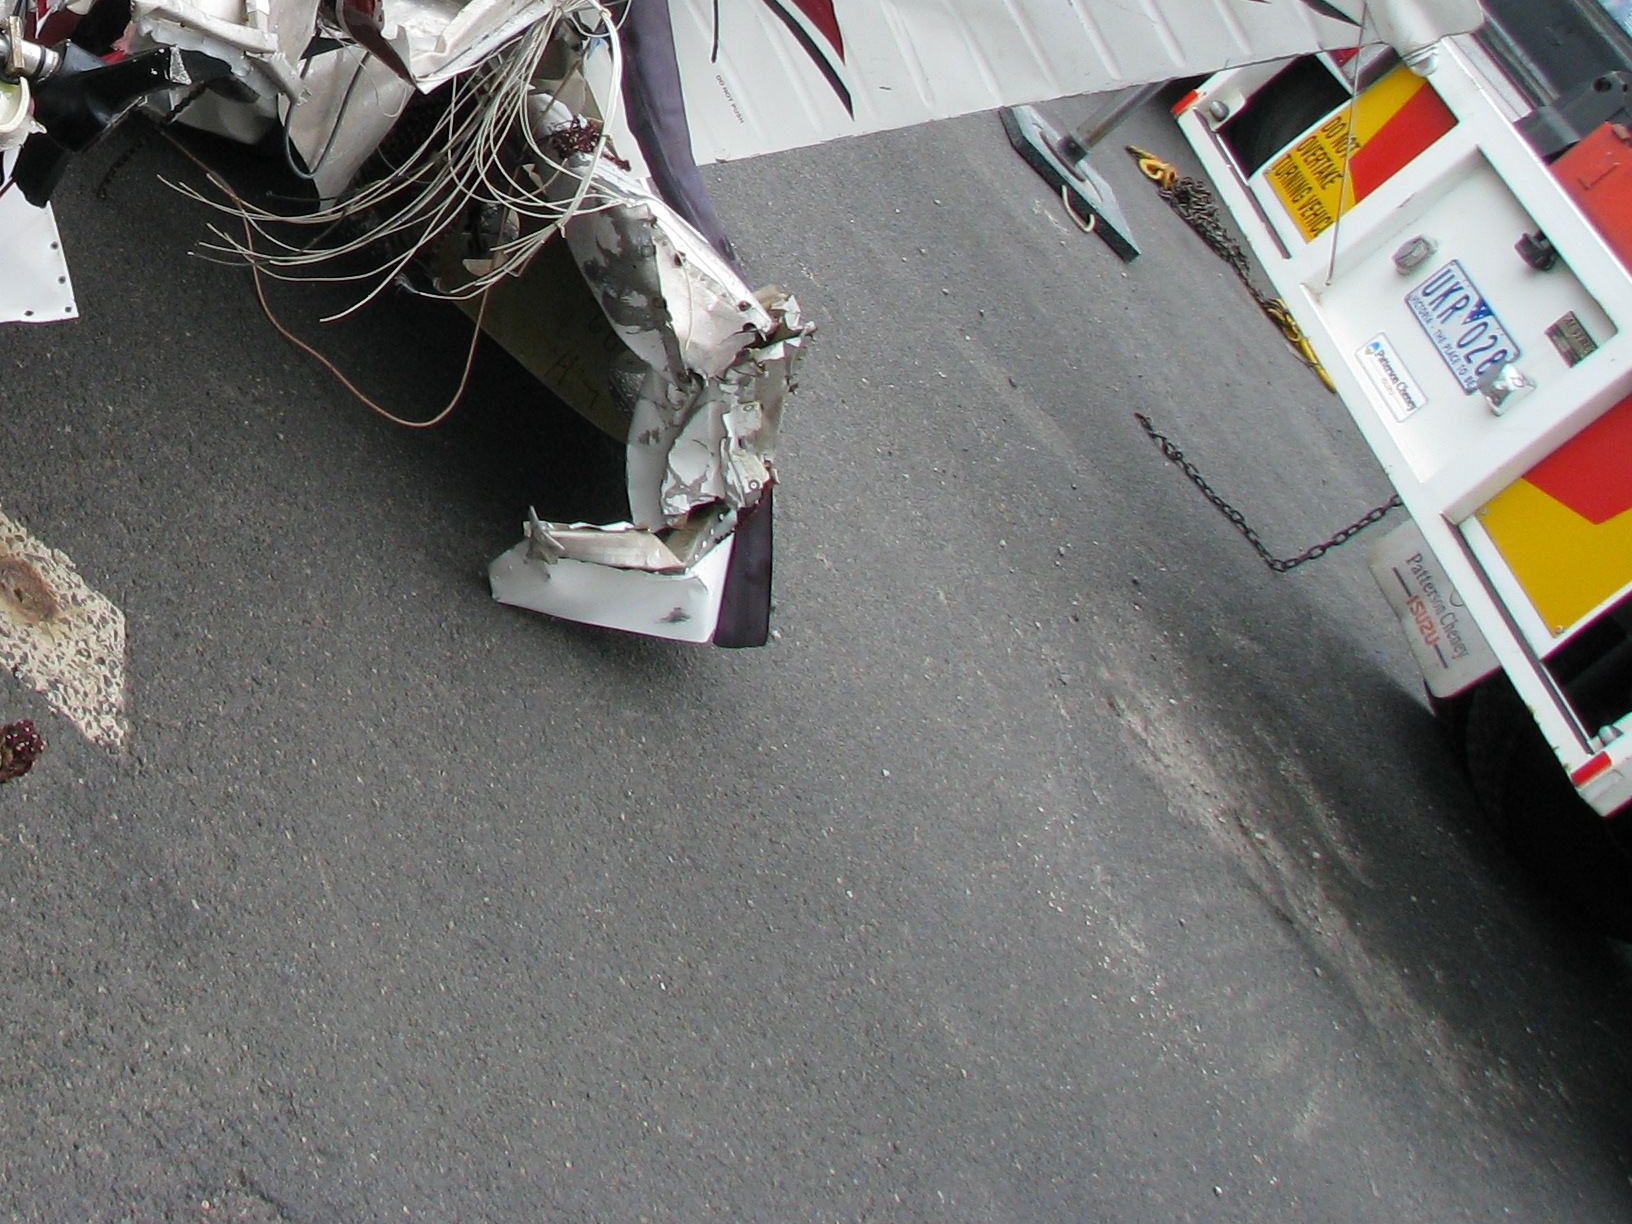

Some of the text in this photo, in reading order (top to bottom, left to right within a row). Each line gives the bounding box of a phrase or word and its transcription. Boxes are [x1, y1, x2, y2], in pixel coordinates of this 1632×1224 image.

[715, 74, 744, 124] DO NOT PUSH
[1296, 135, 1344, 190] OVERTAKE
[1321, 116, 1361, 159] DO NOT
[1271, 153, 1313, 204] TURNING
[1421, 268, 1470, 324] UKR
[1411, 296, 1433, 324] VICTORIA
[1435, 328, 1447, 344] THE
[1443, 342, 1461, 365] PLACE
[1457, 363, 1469, 376] TO
[1374, 349, 1417, 411] Patterson Cheney
[1406, 552, 1470, 659] Patterson Cheney
[1406, 595, 1441, 646] ISUZU
